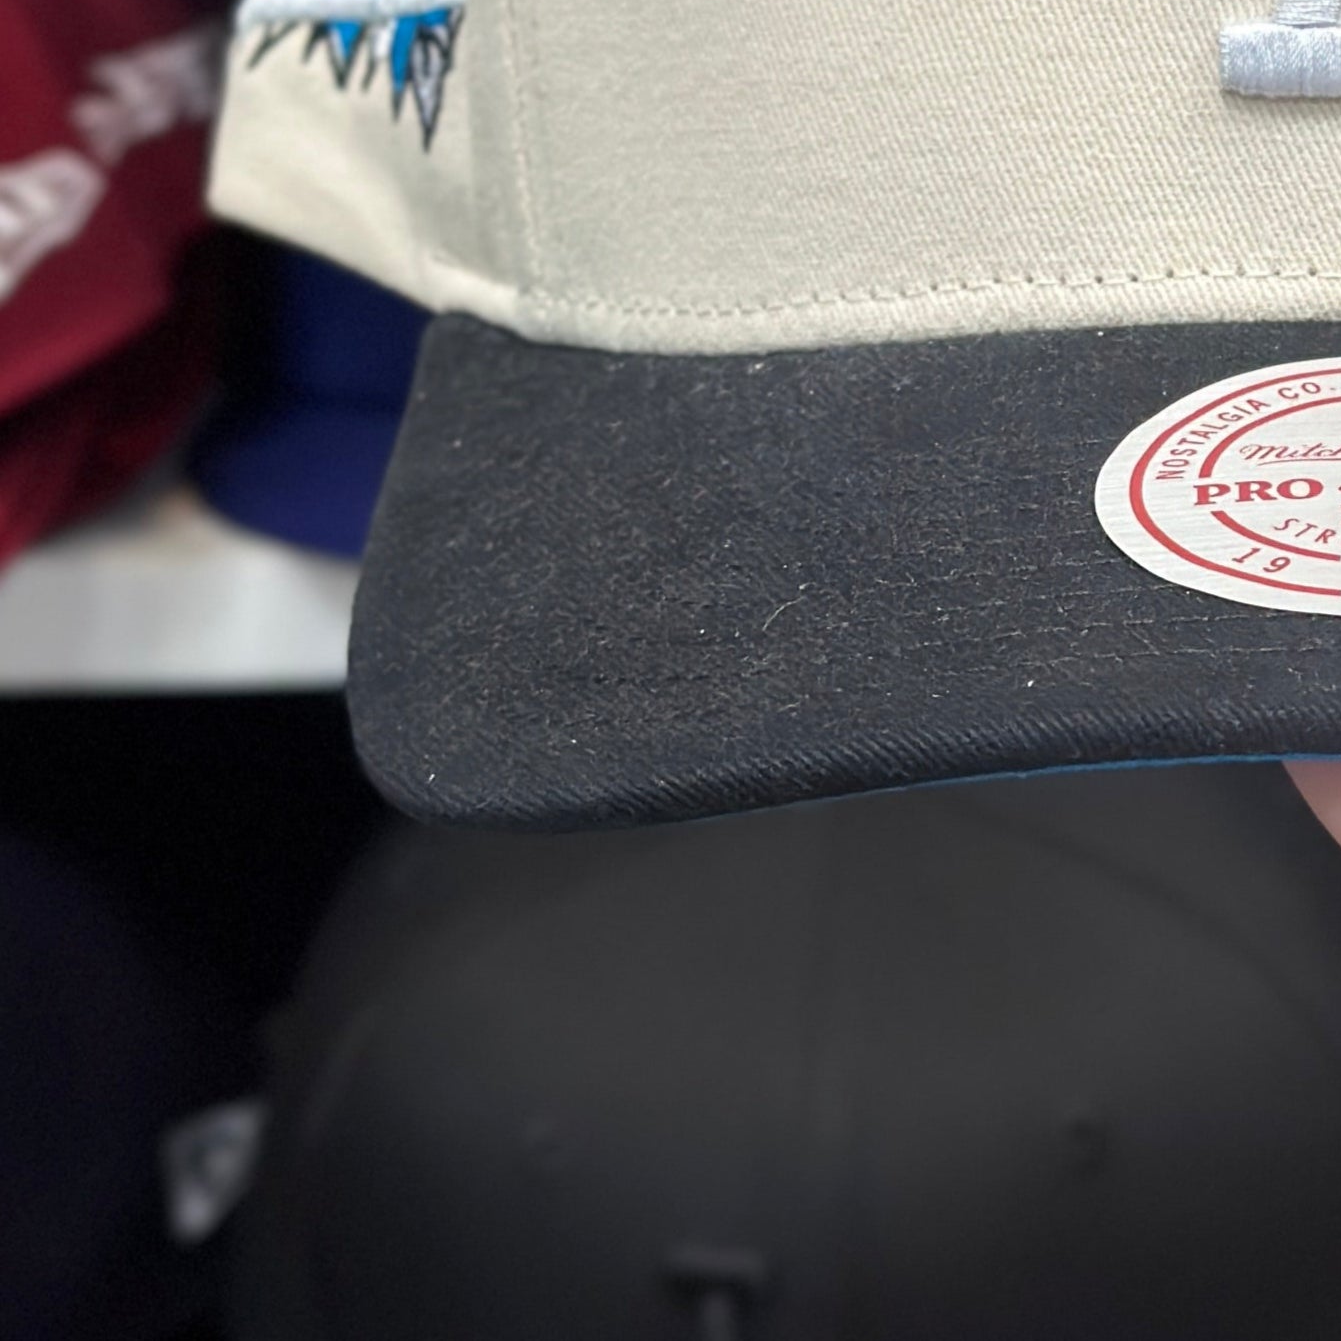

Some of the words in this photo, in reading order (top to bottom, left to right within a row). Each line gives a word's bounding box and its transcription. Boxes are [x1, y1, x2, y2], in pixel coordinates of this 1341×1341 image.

[1155, 397, 1271, 480] NOSTALGIA
[1277, 381, 1337, 401] CO.
[1193, 478, 1324, 506] PRO
[1231, 547, 1291, 573] 19
